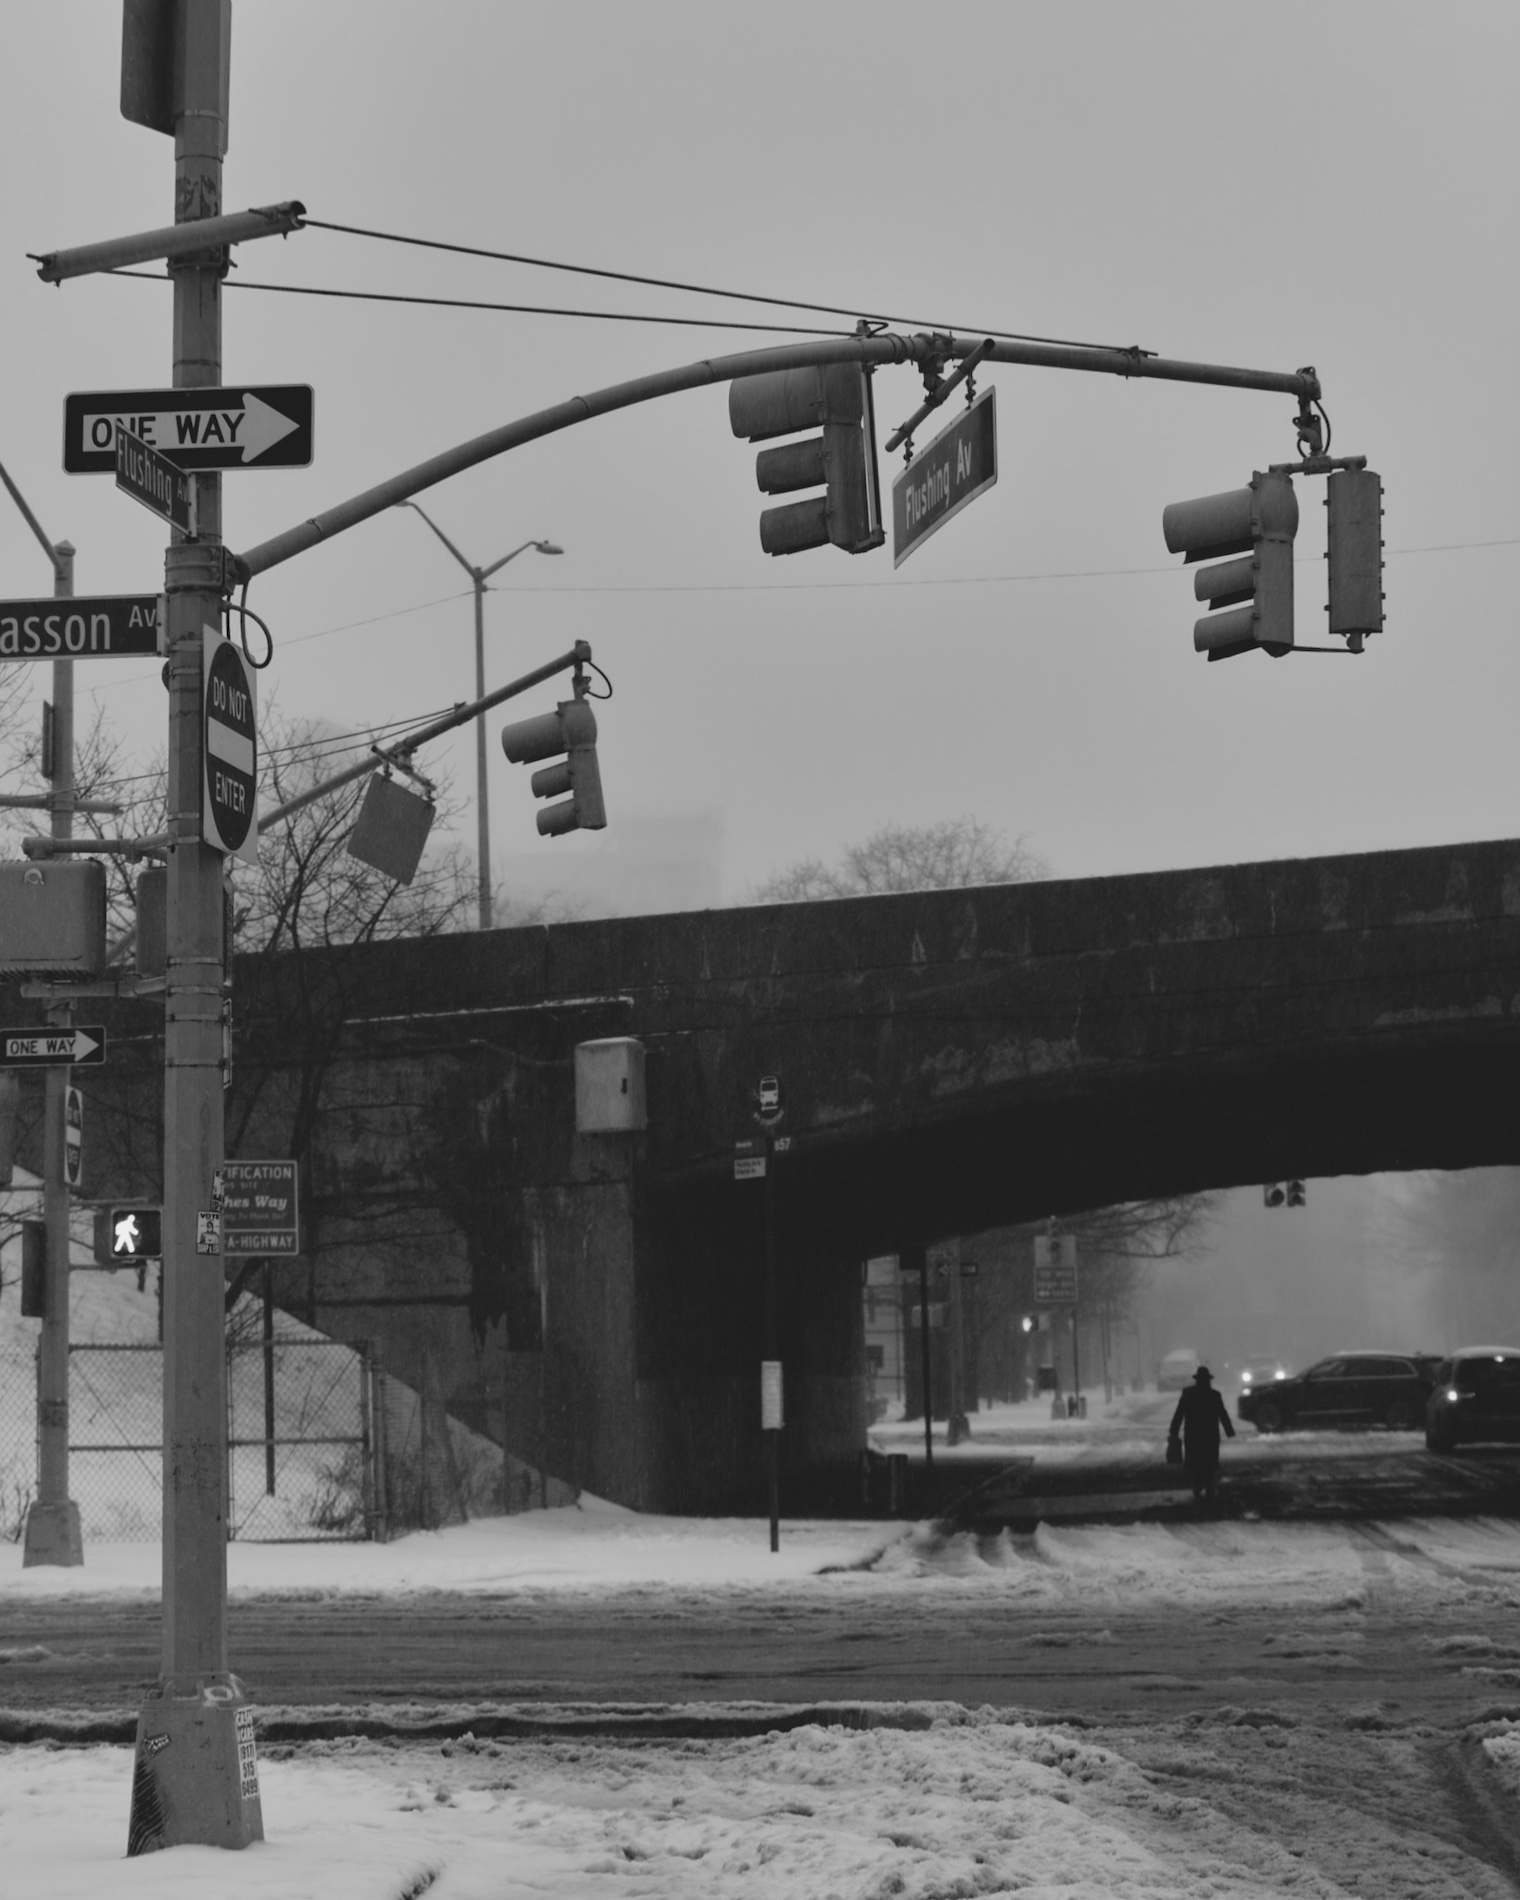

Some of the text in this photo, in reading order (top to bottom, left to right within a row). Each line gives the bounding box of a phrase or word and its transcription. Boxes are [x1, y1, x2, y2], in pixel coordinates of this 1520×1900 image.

[175, 412, 246, 445] WAY
[117, 432, 172, 517] Flushing
[905, 438, 972, 530] Flushing Av
[0, 605, 157, 654] asson Av
[213, 676, 247, 723] DO NOT
[215, 771, 246, 815] ENTER
[10, 1038, 77, 1055] ONE WAY
[254, 1195, 288, 1211] Way
